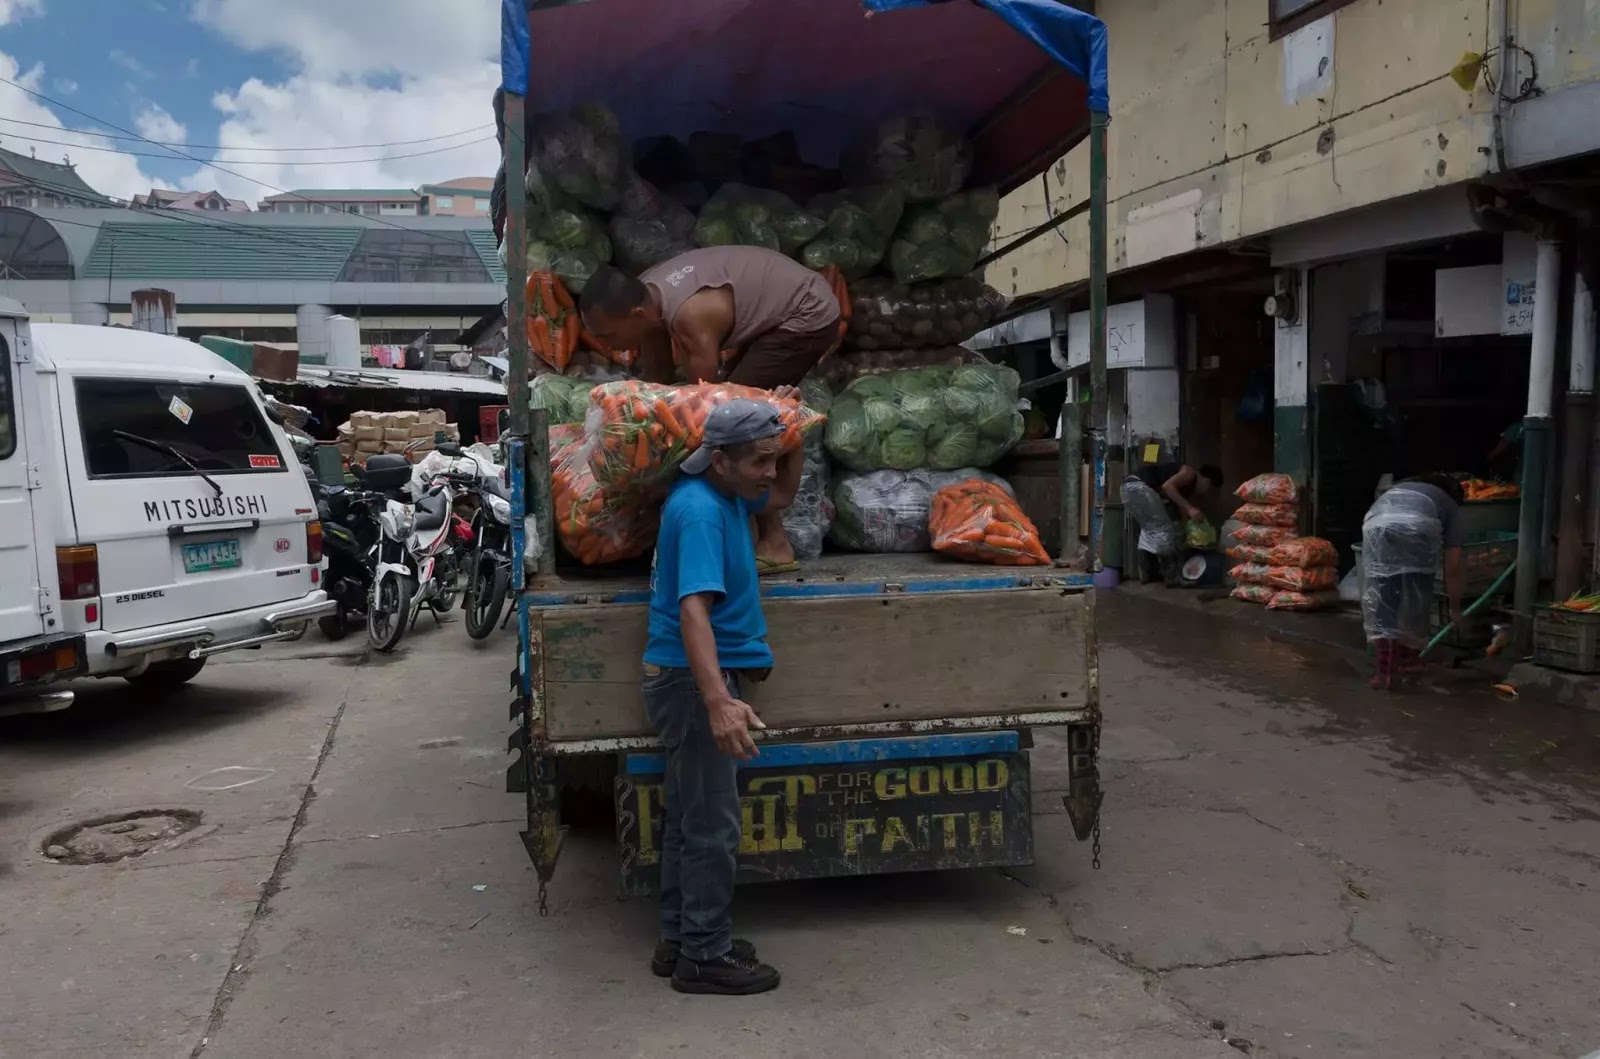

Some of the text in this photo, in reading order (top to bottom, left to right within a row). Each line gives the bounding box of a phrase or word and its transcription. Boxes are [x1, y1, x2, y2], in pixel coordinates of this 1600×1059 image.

[144, 495, 268, 522] MITSUBISHI
[131, 590, 165, 601] DIESEL
[818, 771, 872, 789] FOR
[875, 759, 1009, 801] GOOD
[818, 789, 873, 806] THE
[843, 810, 1005, 854] FAITH
